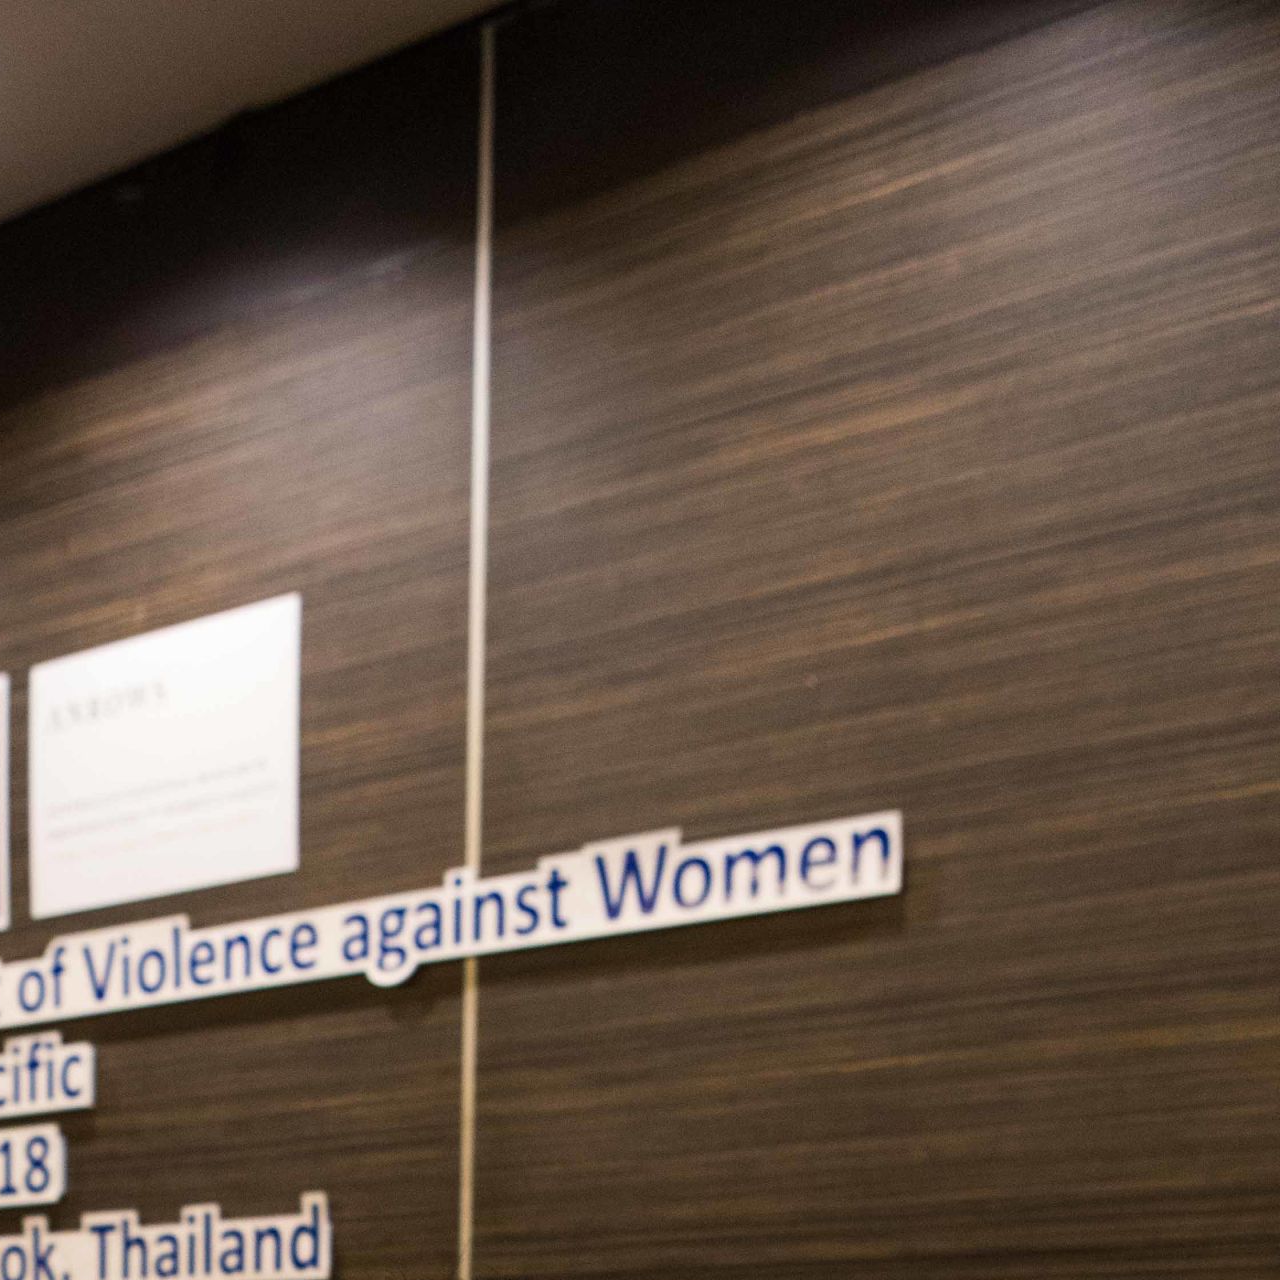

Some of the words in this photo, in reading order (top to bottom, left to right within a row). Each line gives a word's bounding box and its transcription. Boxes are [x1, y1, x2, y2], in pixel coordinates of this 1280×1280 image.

[19, 946, 66, 1012] of
[84, 921, 318, 1001] Violence
[342, 868, 568, 972] against
[595, 827, 891, 920] Women
